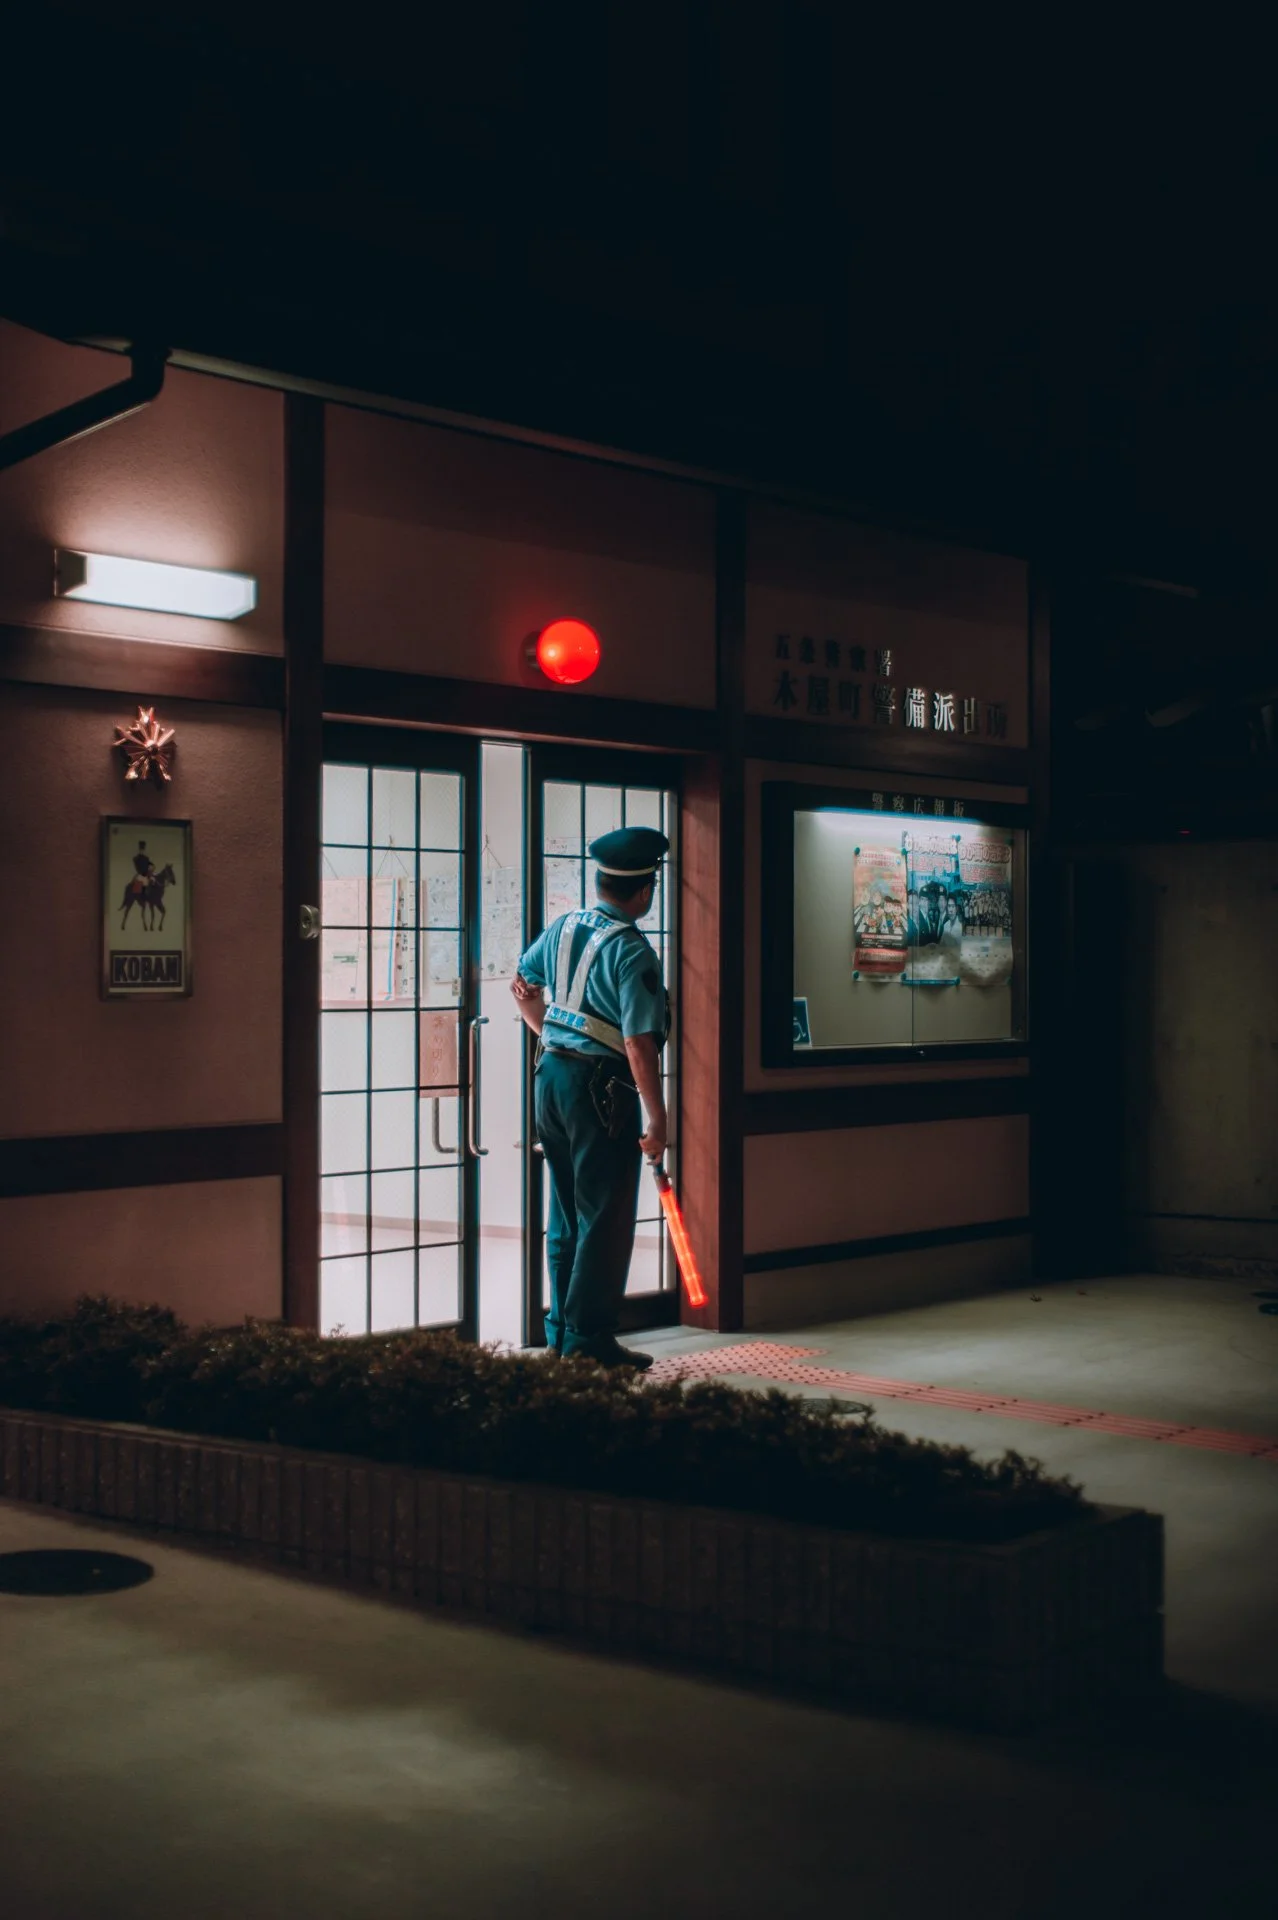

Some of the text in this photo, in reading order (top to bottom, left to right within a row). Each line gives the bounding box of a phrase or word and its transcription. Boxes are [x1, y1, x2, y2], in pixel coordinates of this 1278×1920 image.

[774, 670, 1008, 739] 木屋町警備派出所
[114, 956, 179, 983] KOBAN
